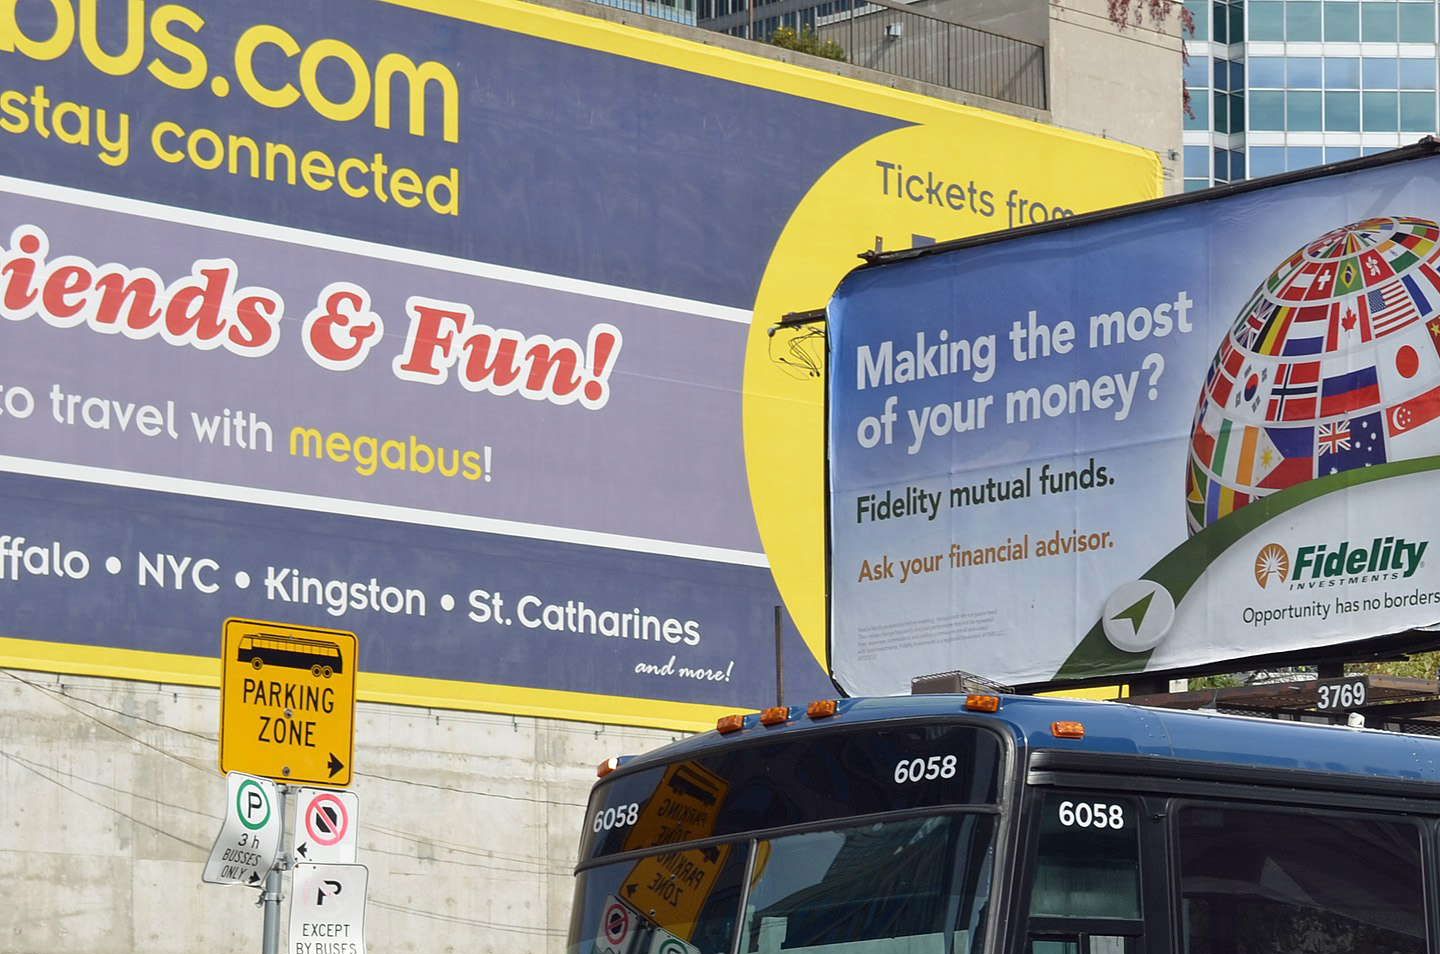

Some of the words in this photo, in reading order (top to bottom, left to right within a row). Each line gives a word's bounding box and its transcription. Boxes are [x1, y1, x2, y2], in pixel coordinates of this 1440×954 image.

[0, 85, 129, 167] stay
[151, 119, 459, 216] connected
[875, 159, 995, 218] Tickets
[0, 230, 279, 350] iends
[307, 289, 378, 363] &
[399, 302, 617, 404] Fun!
[855, 328, 997, 391] Making
[1009, 310, 1075, 363] the
[1088, 290, 1194, 350] most
[856, 396, 898, 449] of
[907, 394, 994, 455] your
[1005, 352, 1166, 426] money?
[50, 383, 179, 440] travel
[190, 407, 273, 453] with
[289, 425, 493, 483] megabus!
[856, 486, 942, 524] Fidelity
[949, 467, 1031, 509] mutual
[1038, 457, 1116, 496] funds.
[857, 554, 895, 583] Ask
[899, 552, 944, 584] your
[948, 533, 1029, 569] financial
[1034, 528, 1115, 558] advisor.
[1291, 536, 1429, 581] Fidelity
[138, 550, 221, 594] NYC
[264, 566, 426, 617] Kingston
[1289, 572, 1399, 591] INVESTMENTS
[1242, 600, 1331, 627] Opportunity
[1335, 597, 1360, 615] has
[1362, 597, 1381, 612] no
[634, 654, 677, 676] and
[678, 660, 735, 683] more!
[242, 677, 335, 714] PARKING
[1316, 681, 1366, 711] 3769
[257, 716, 317, 748] ZONE
[893, 753, 958, 784] 6058
[247, 791, 263, 819] P
[592, 802, 640, 833] 6058
[1057, 800, 1125, 829] 6058
[220, 865, 248, 881] ONLY
[222, 848, 262, 867] BUSSES
[302, 923, 351, 938] EXCEPT
